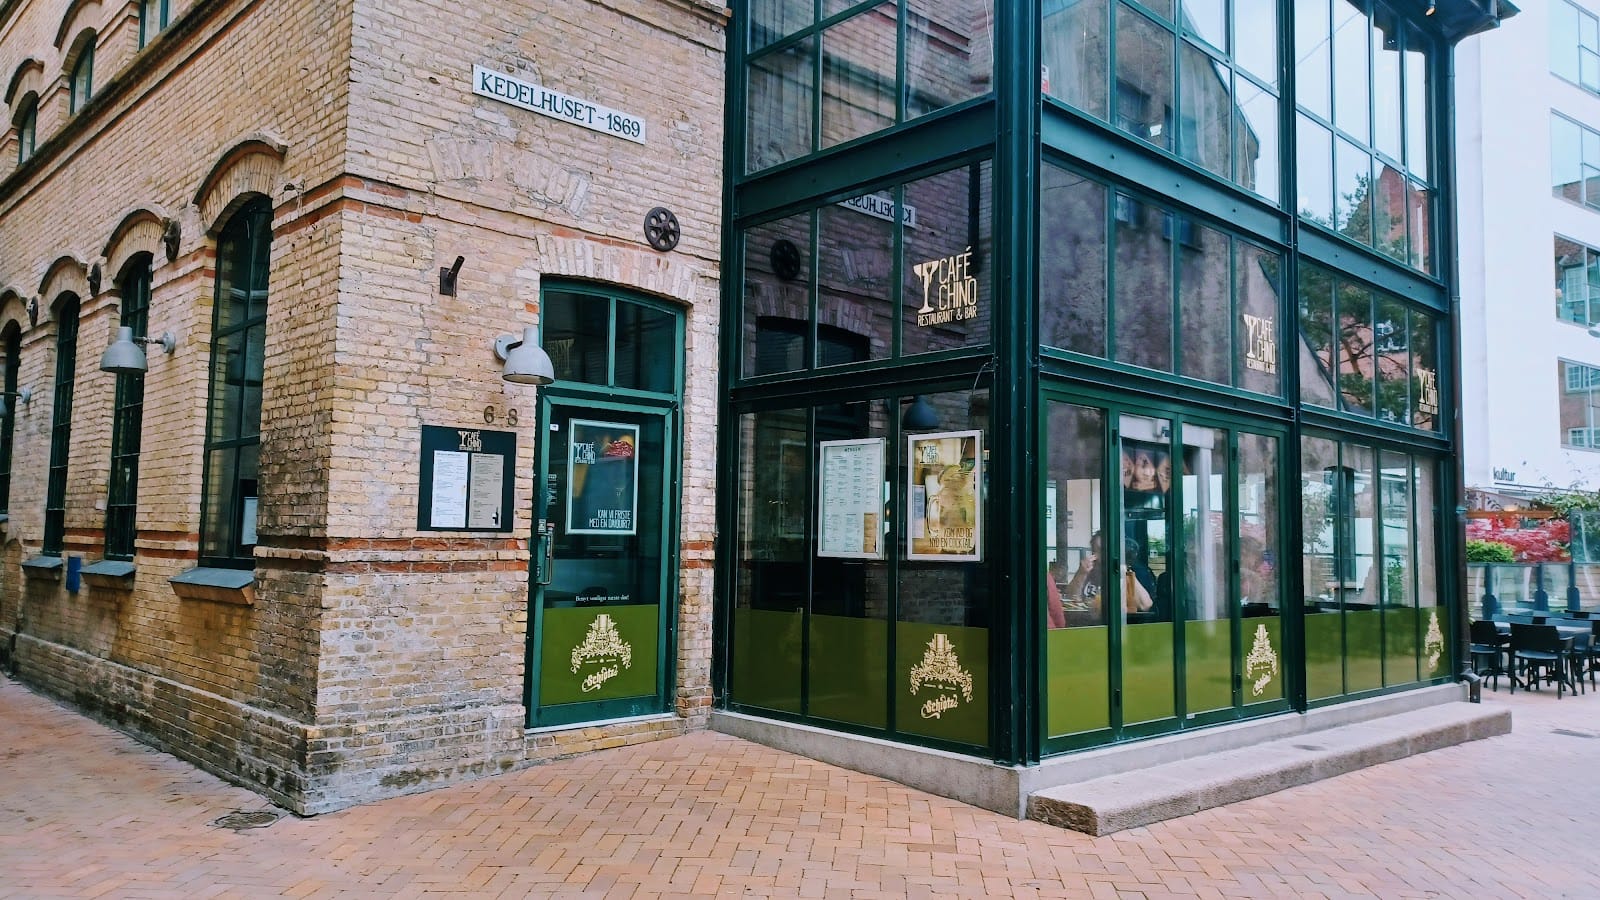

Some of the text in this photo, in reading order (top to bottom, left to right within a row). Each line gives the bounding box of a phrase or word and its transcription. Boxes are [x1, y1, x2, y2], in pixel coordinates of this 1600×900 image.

[939, 246, 973, 285] CAFÉ
[939, 278, 977, 311] CHINO
[917, 305, 977, 328] RESTAURANT & BAR
[1257, 316, 1273, 343] CAFÉ
[1493, 466, 1516, 481] kultur
[597, 509, 631, 520] KAN VI FRISTE
[589, 518, 599, 528] MED
[601, 519, 607, 528] EN
[965, 527, 973, 538] OG
[929, 537, 940, 548] NYD
[941, 537, 948, 548] EN
